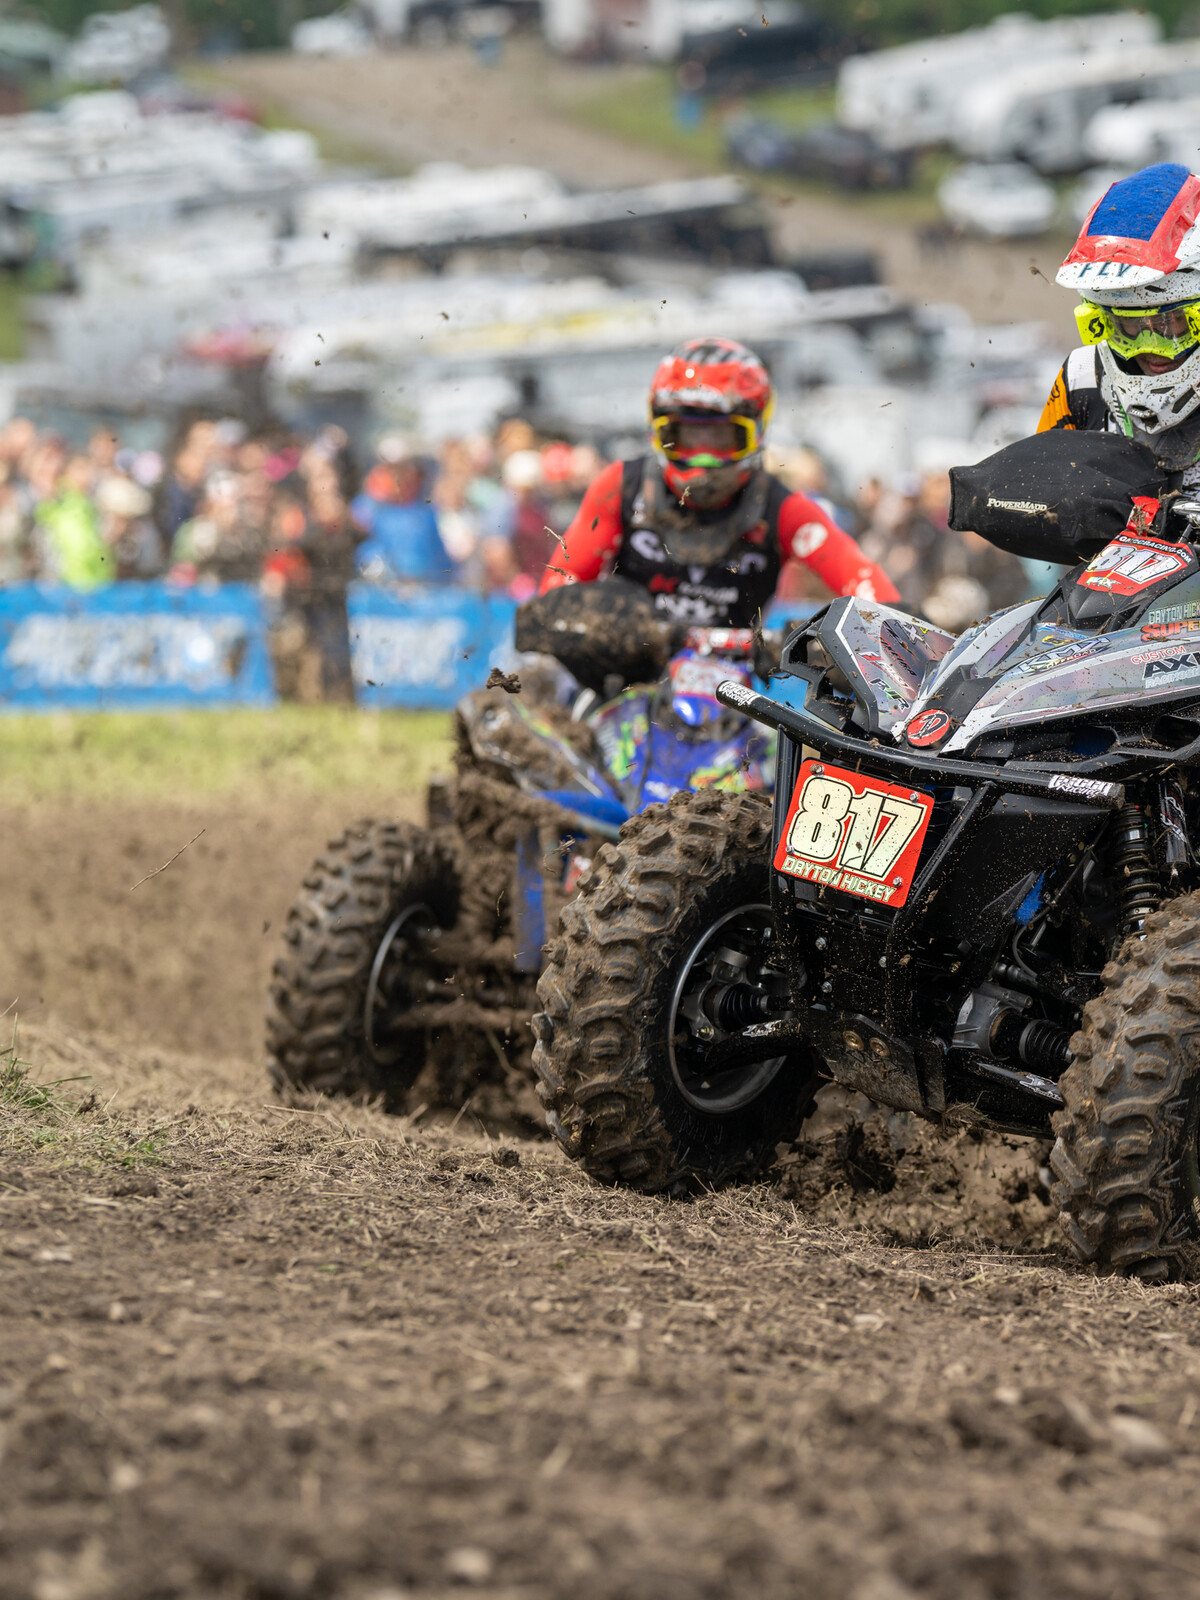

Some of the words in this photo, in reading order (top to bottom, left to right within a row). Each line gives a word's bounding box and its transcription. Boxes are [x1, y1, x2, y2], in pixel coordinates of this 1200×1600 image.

[1086, 543, 1182, 584] 817
[1149, 605, 1183, 625] DAYTON
[1131, 646, 1187, 665] CUSTOM
[787, 774, 928, 882] 817
[781, 855, 842, 887] DAYTON
[839, 874, 896, 903] HICKEY
